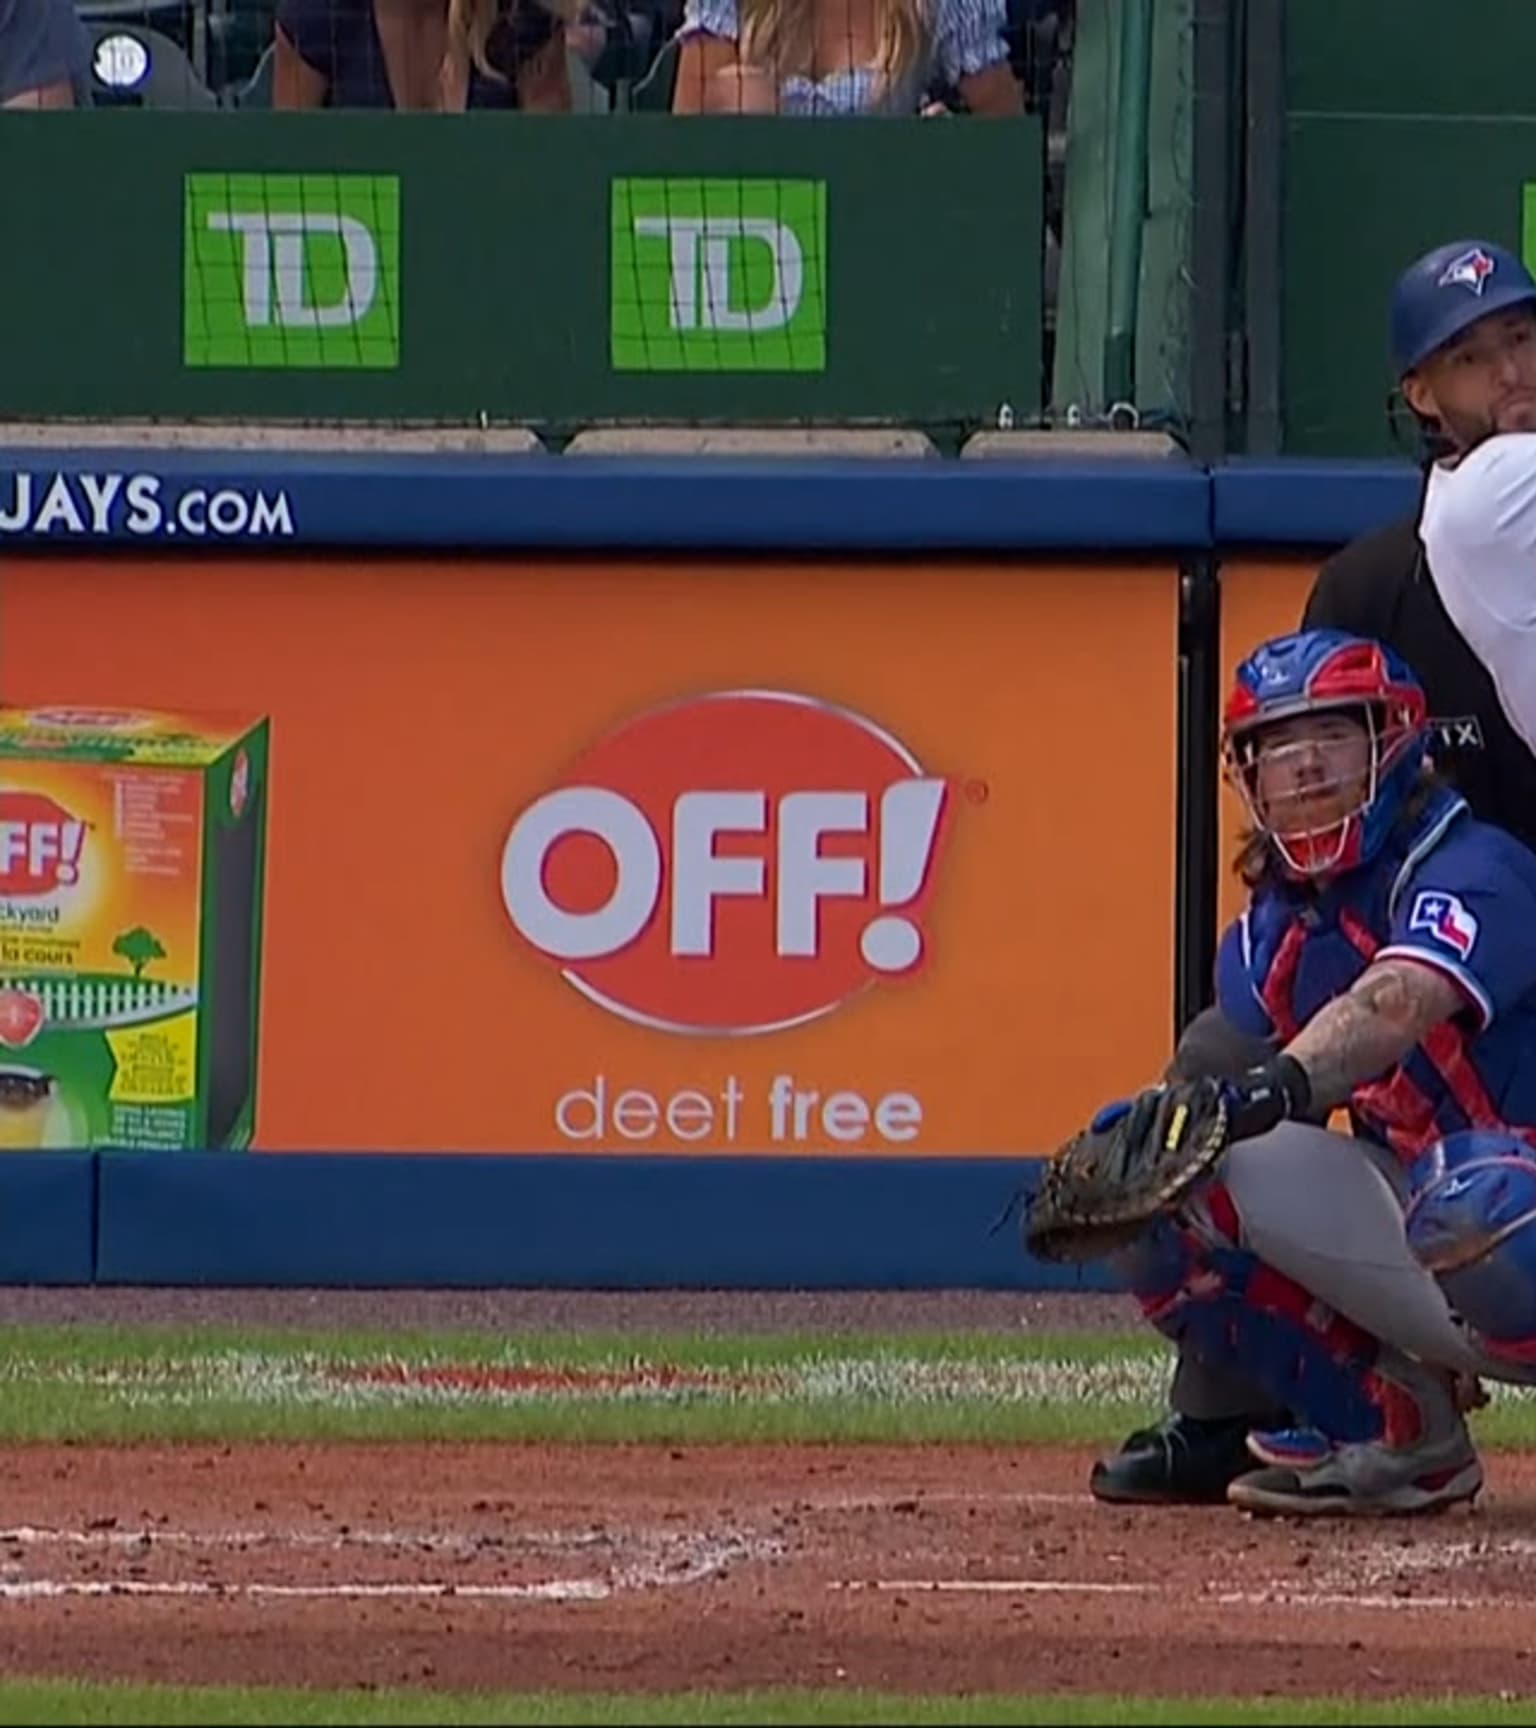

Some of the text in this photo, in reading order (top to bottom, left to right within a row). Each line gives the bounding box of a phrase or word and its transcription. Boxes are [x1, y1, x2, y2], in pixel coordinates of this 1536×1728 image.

[207, 212, 377, 328] TD
[634, 216, 804, 332] TD
[501, 778, 947, 971] OFF!
[555, 1074, 923, 1142] deet free
